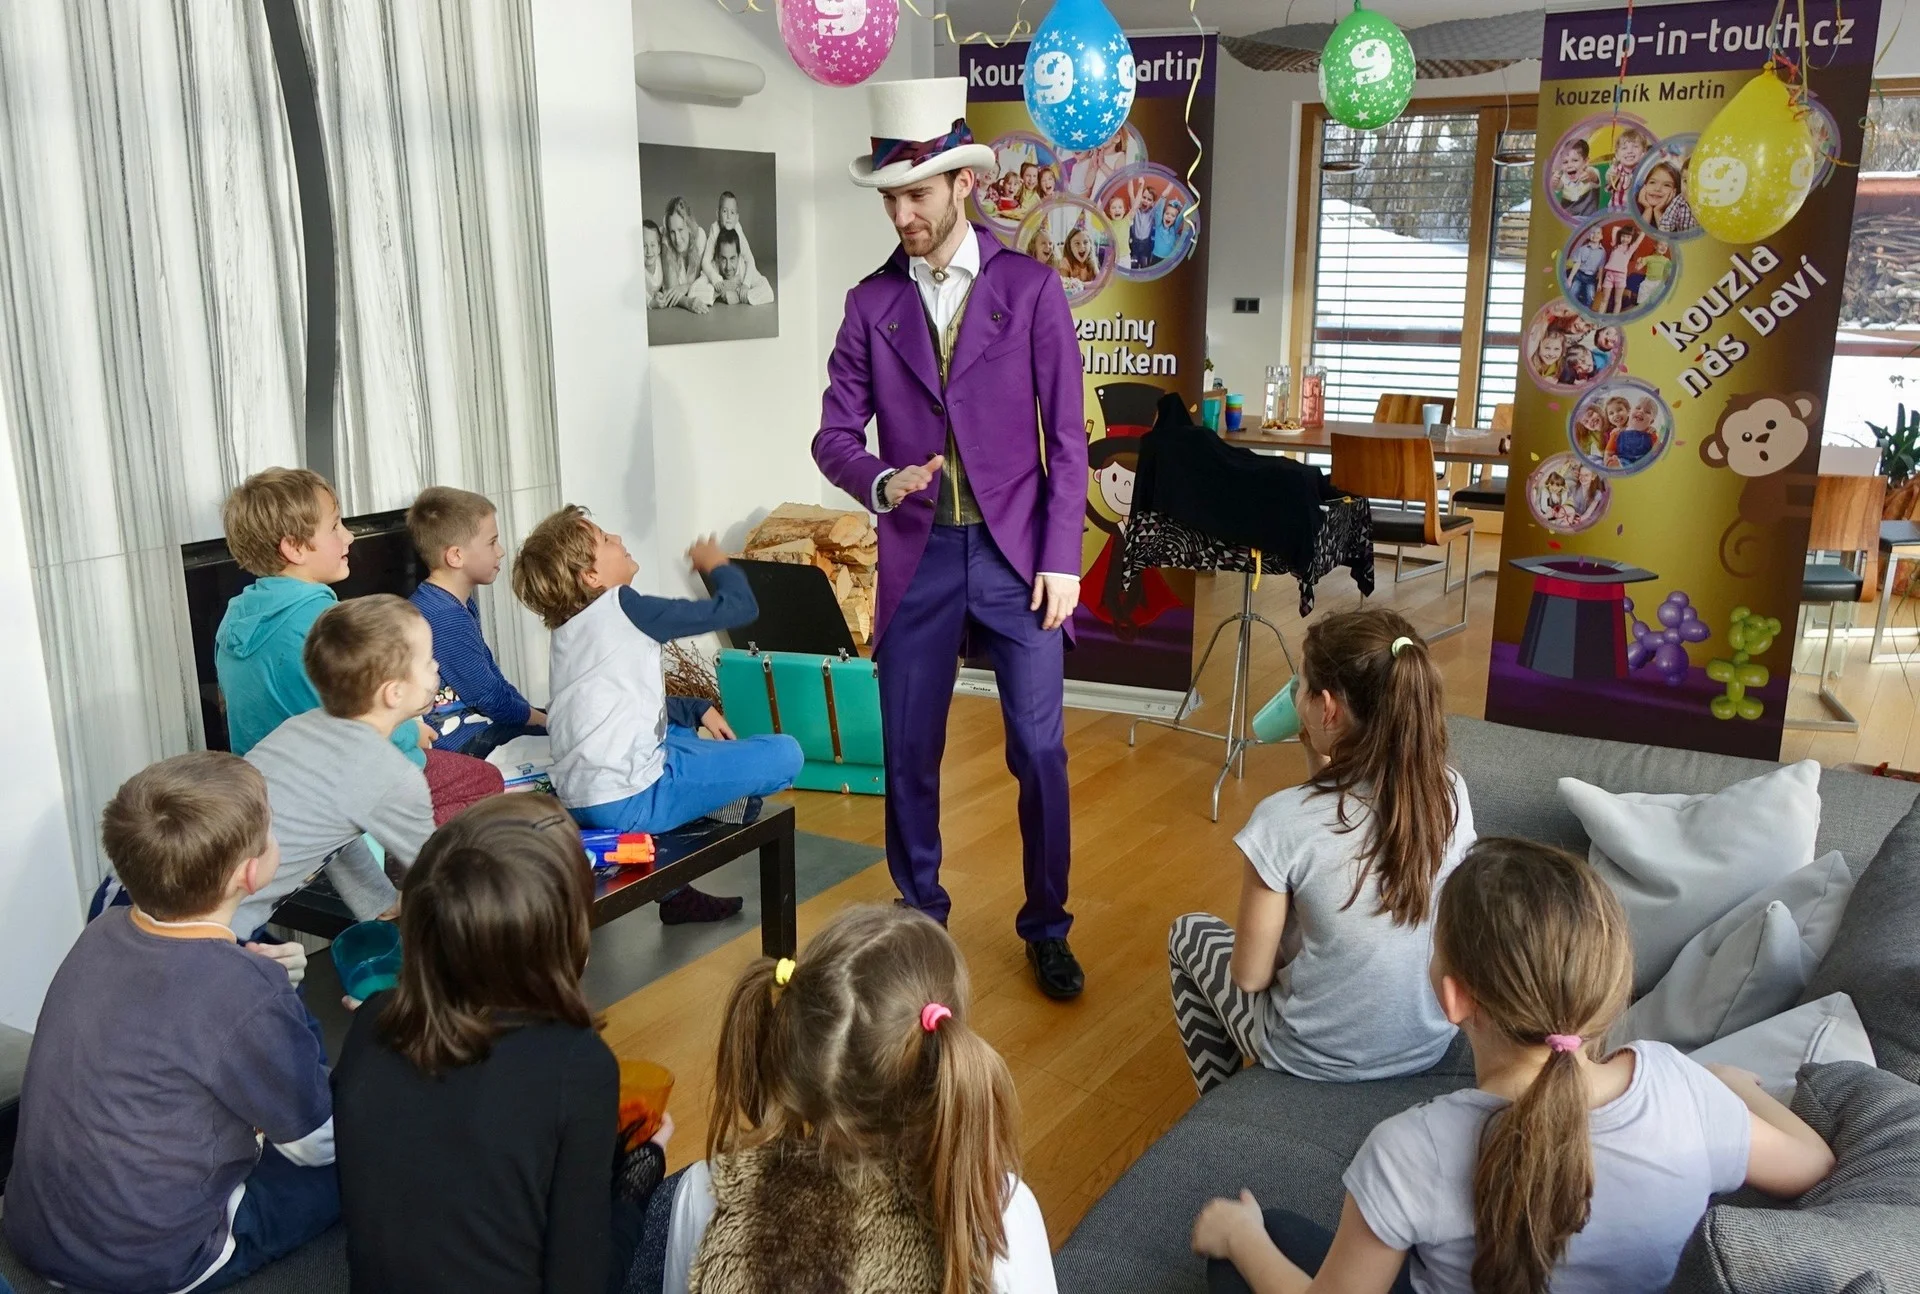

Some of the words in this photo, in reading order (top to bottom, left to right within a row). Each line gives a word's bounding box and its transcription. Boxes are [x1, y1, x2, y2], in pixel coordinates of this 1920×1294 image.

[1349, 38, 1393, 86] 9
[1559, 13, 1855, 67] keep-in-touch.cz
[970, 57, 1025, 87] kouz
[1136, 49, 1202, 82] artin
[1033, 51, 1074, 104] 9
[1555, 83, 1650, 106] kouzelník
[1659, 79, 1726, 101] Martin
[1697, 156, 1748, 207] 9
[1656, 245, 1780, 352] kouzla
[1677, 333, 1747, 398] nás
[1739, 254, 1828, 338] baví
[1081, 345, 1177, 375] lníkem
